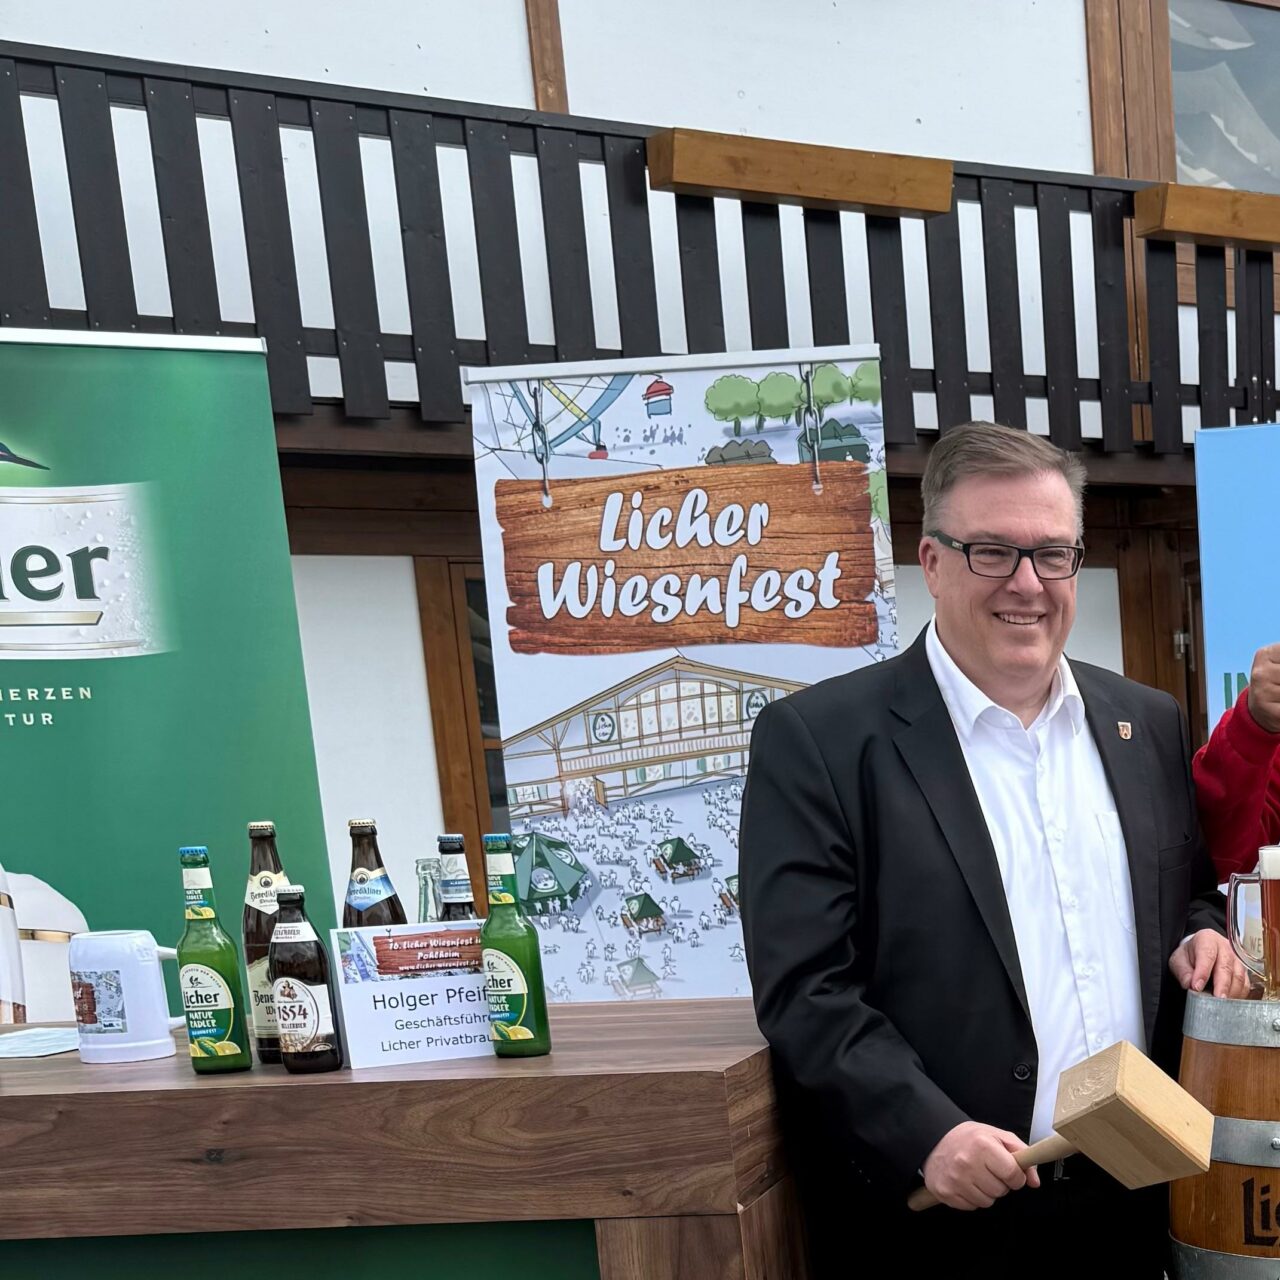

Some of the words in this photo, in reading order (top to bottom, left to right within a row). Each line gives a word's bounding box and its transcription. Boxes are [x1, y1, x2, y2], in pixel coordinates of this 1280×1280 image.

[600, 488, 770, 552] Licher
[537, 551, 842, 629] Wiesnfest
[0, 687, 92, 701] ERZEN
[402, 938, 428, 950] Licher
[429, 937, 474, 950] Wiesnfest
[417, 951, 460, 961] Pohlheim
[372, 991, 439, 1011] Holger
[278, 1004, 308, 1020] 1854
[381, 1039, 422, 1052] Licher
